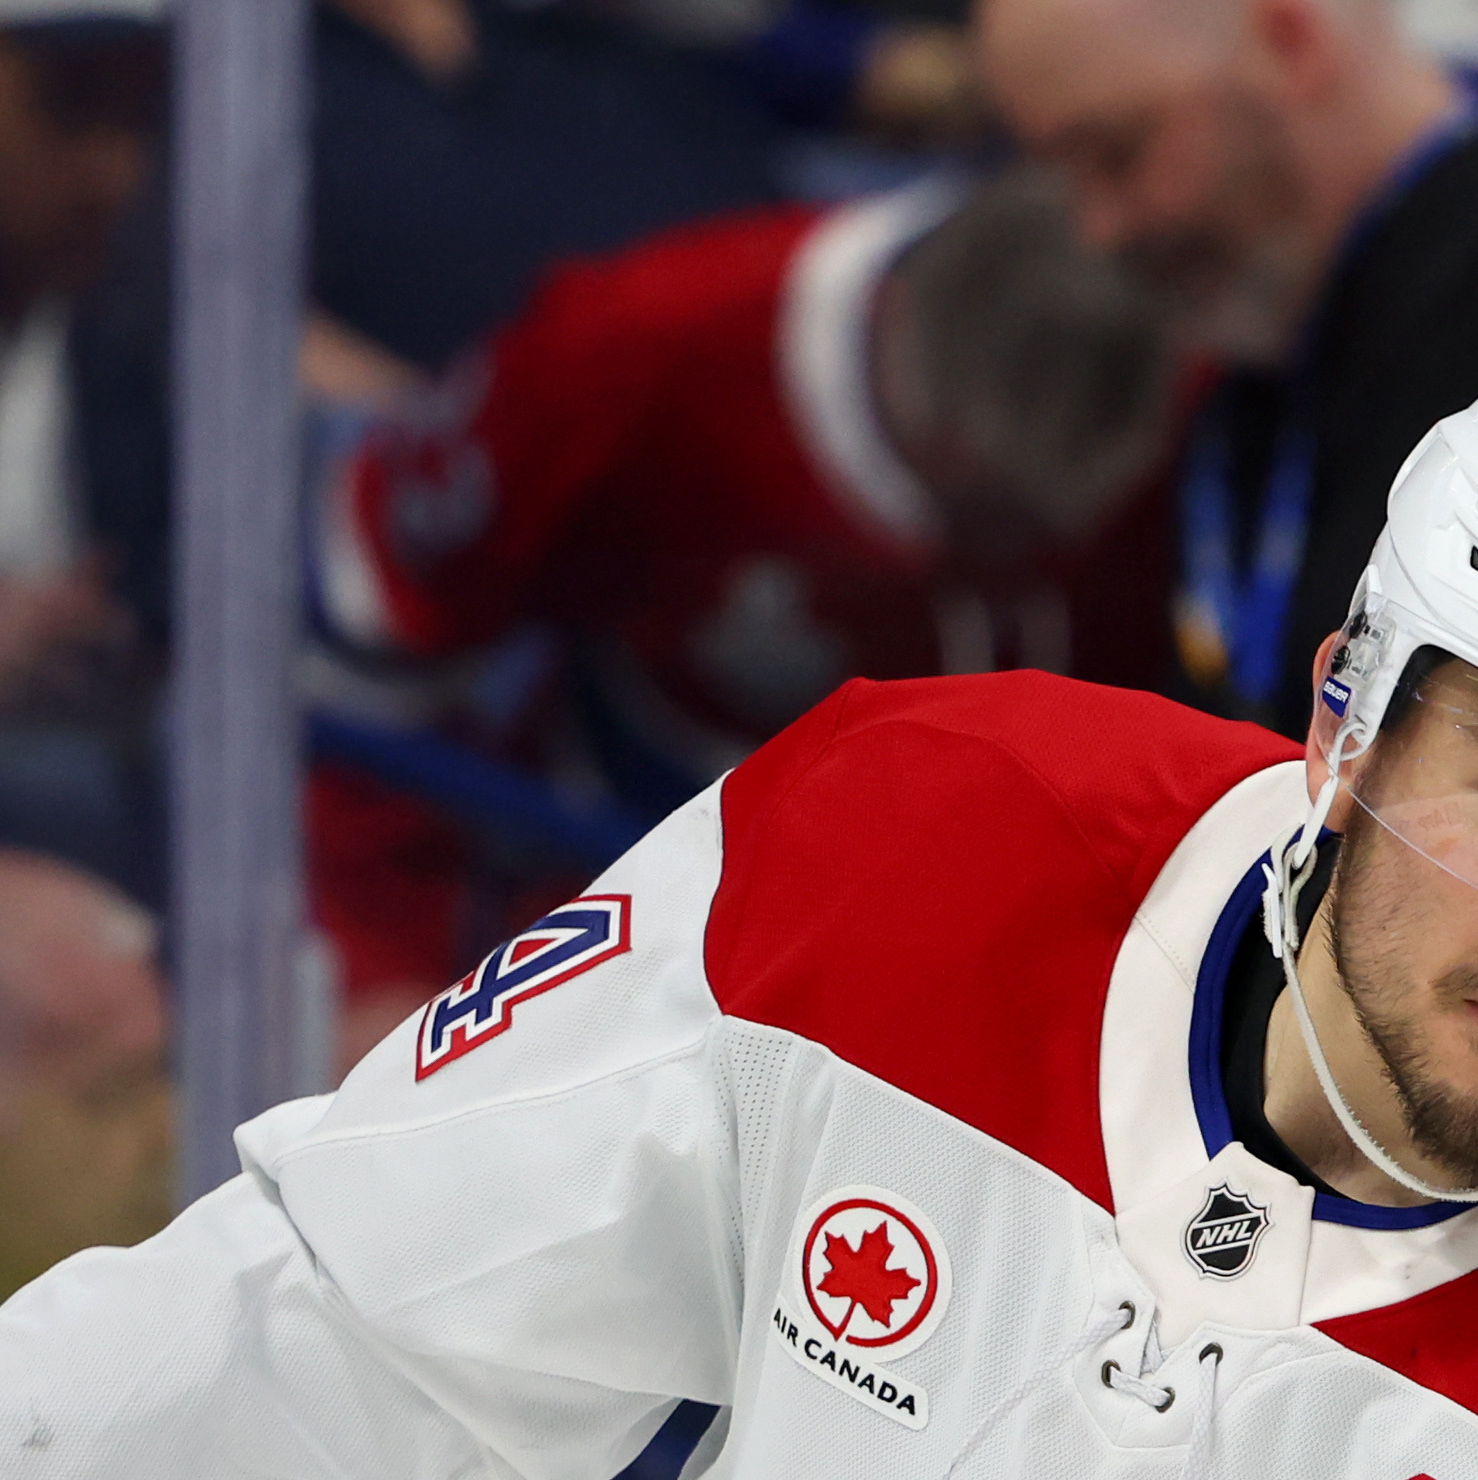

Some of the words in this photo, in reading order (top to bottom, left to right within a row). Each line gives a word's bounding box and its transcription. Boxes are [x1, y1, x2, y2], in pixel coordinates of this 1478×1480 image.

[1194, 1219, 1253, 1249] NHL
[773, 1307, 799, 1348] AIR
[804, 1338, 916, 1417] CANADA
